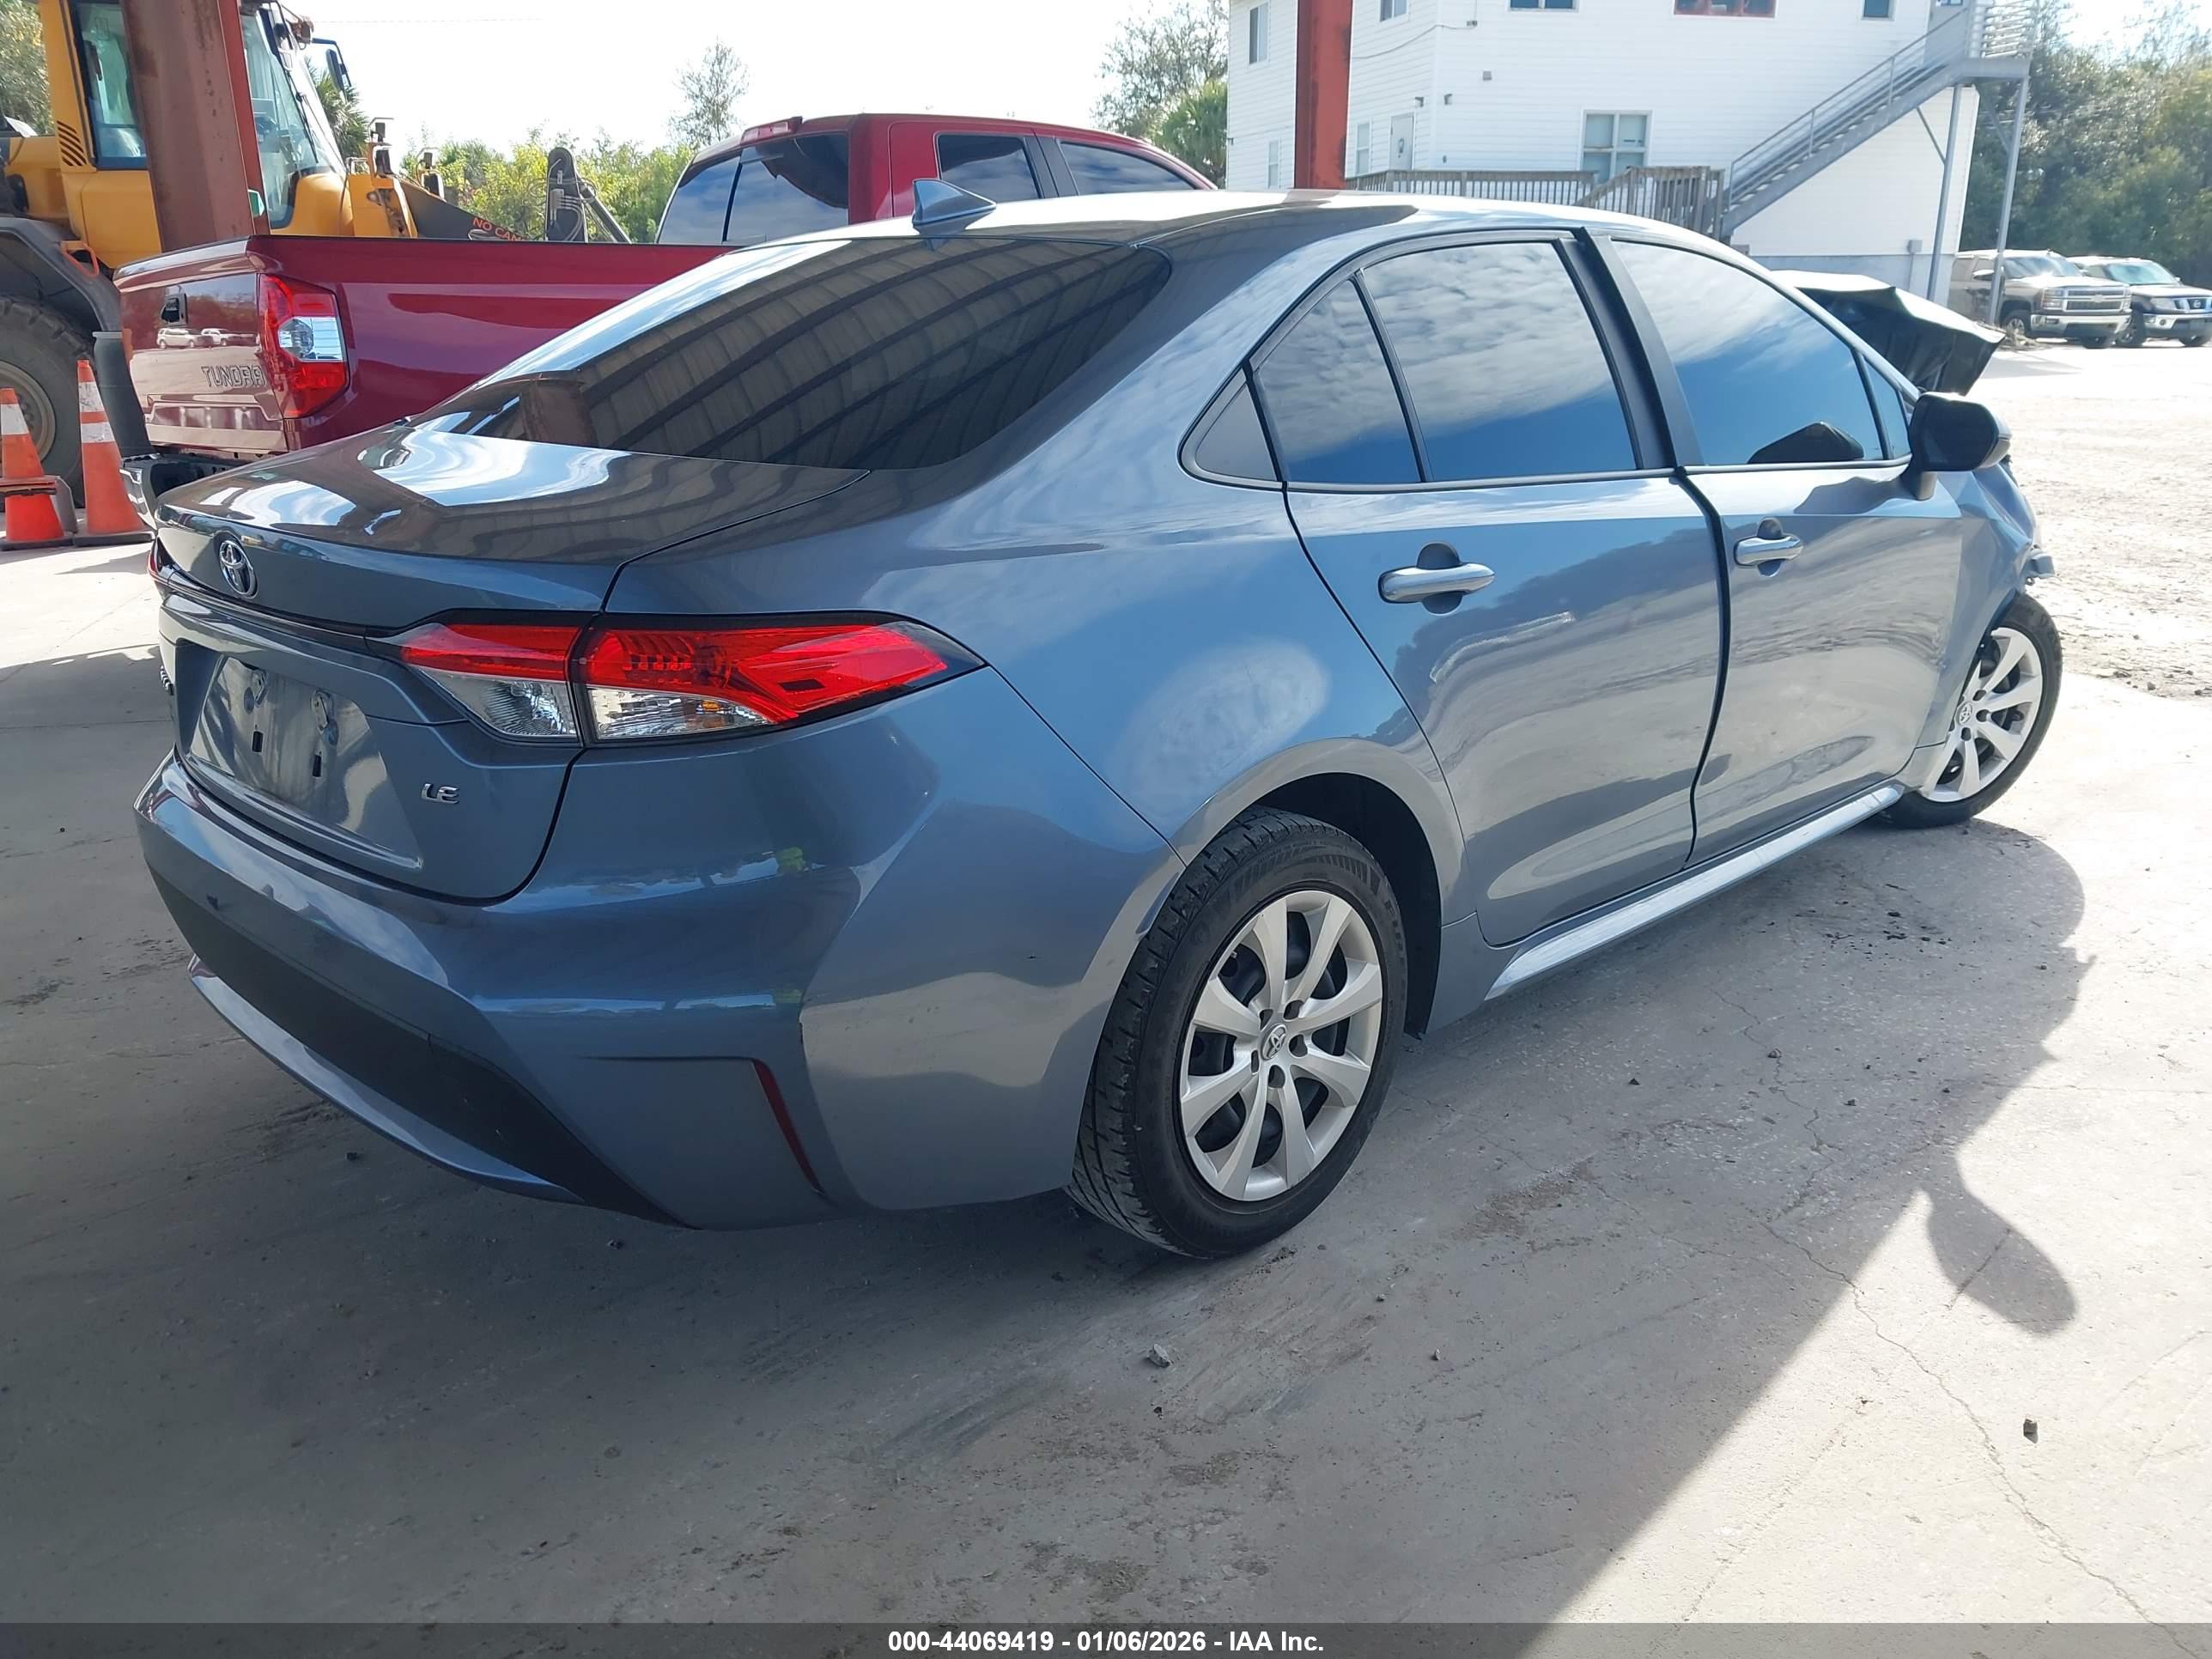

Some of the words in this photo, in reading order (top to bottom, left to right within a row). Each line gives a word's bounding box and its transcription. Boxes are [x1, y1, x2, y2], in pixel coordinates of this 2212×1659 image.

[472, 216, 493, 232] NO
[200, 365, 267, 388] TUNDRA
[421, 783, 459, 805] LE
